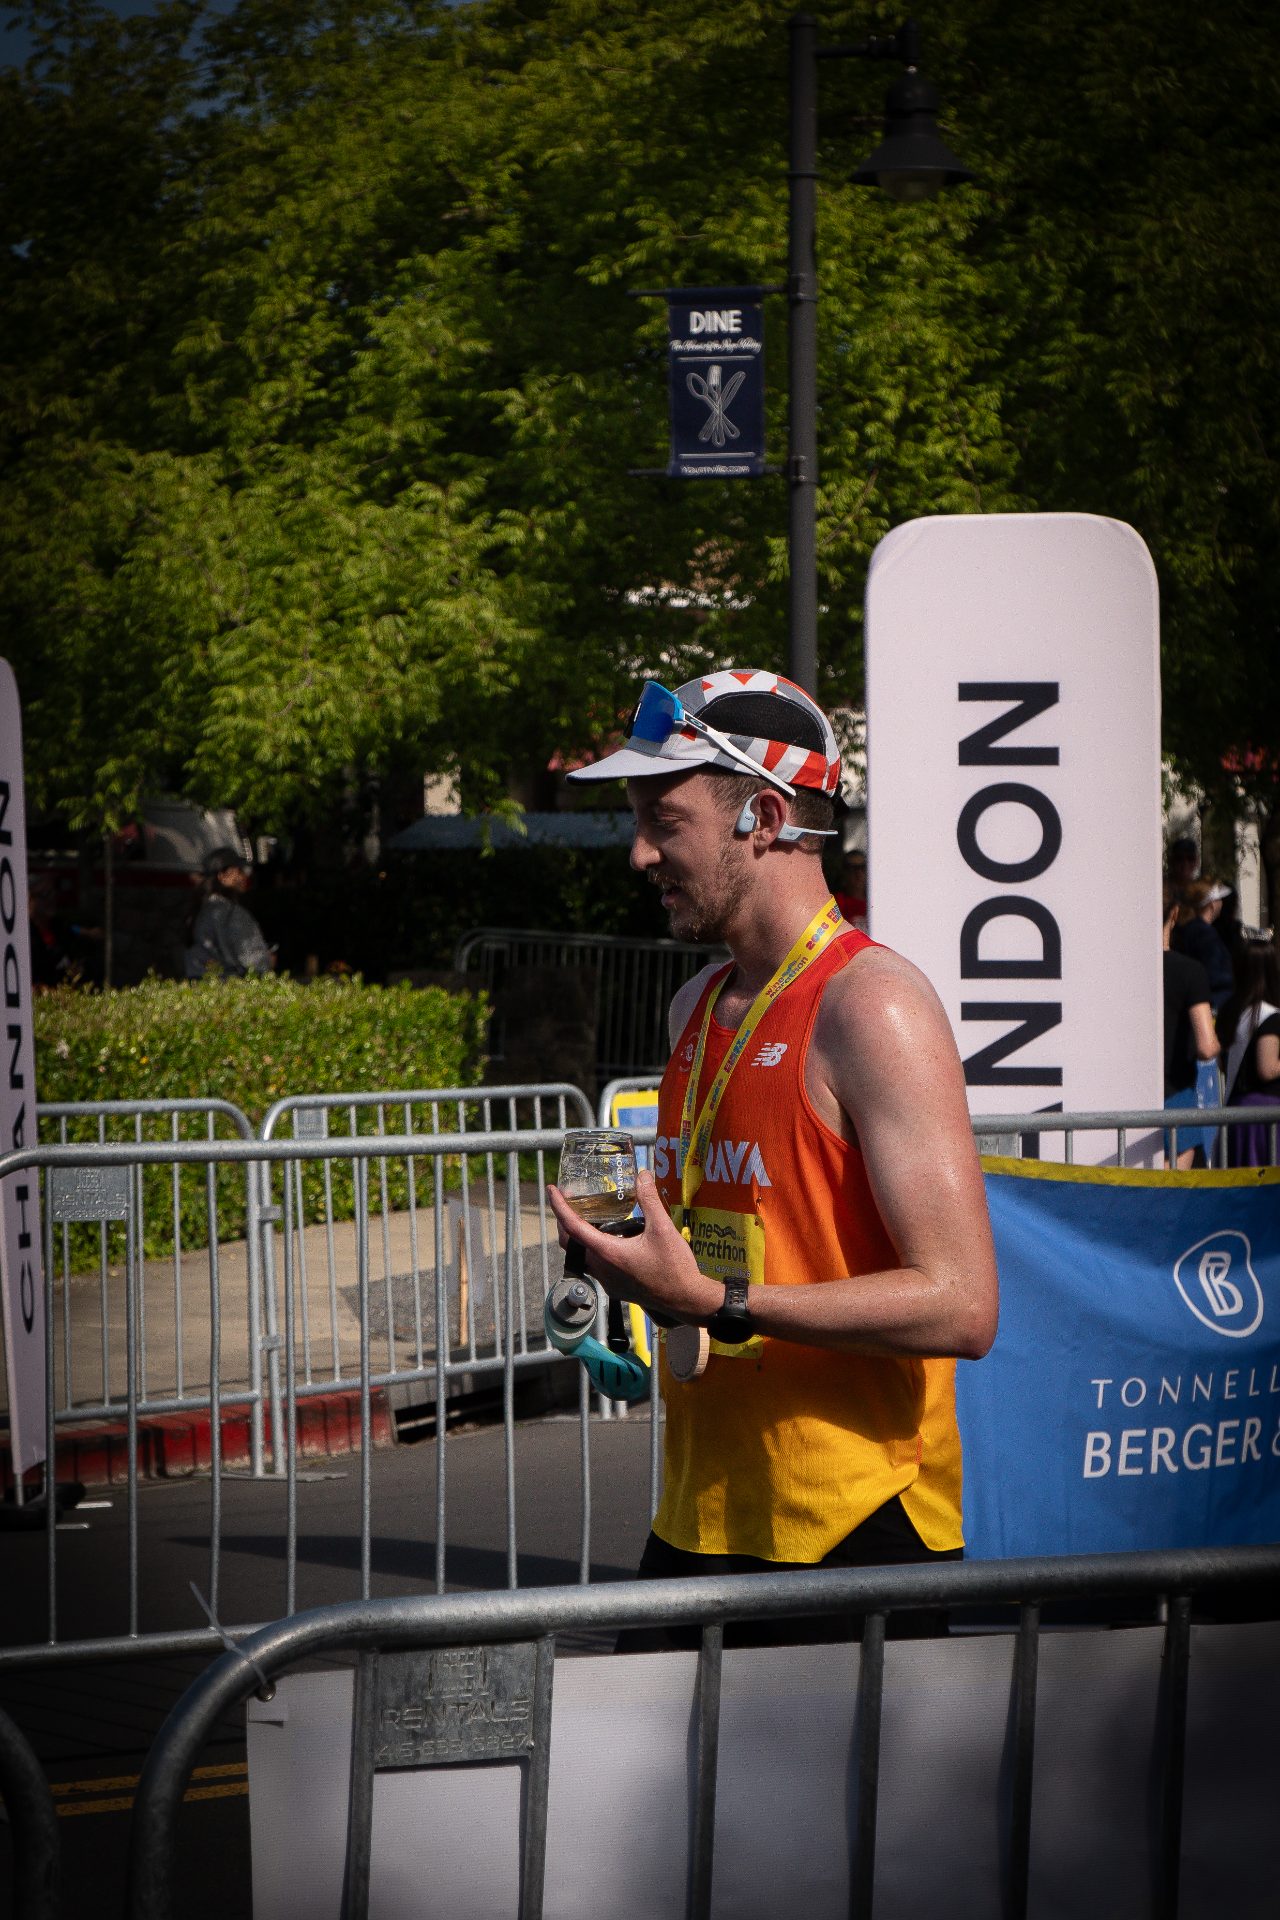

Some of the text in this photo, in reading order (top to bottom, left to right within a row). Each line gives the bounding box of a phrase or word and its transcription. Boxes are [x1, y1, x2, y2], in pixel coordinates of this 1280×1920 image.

[689, 309, 743, 334] DINE
[956, 682, 1063, 1160] NDON
[616, 1153, 625, 1201] CHANDON
[1083, 1417, 1262, 1479] BERGER
[379, 1698, 531, 1732] RENTALS
